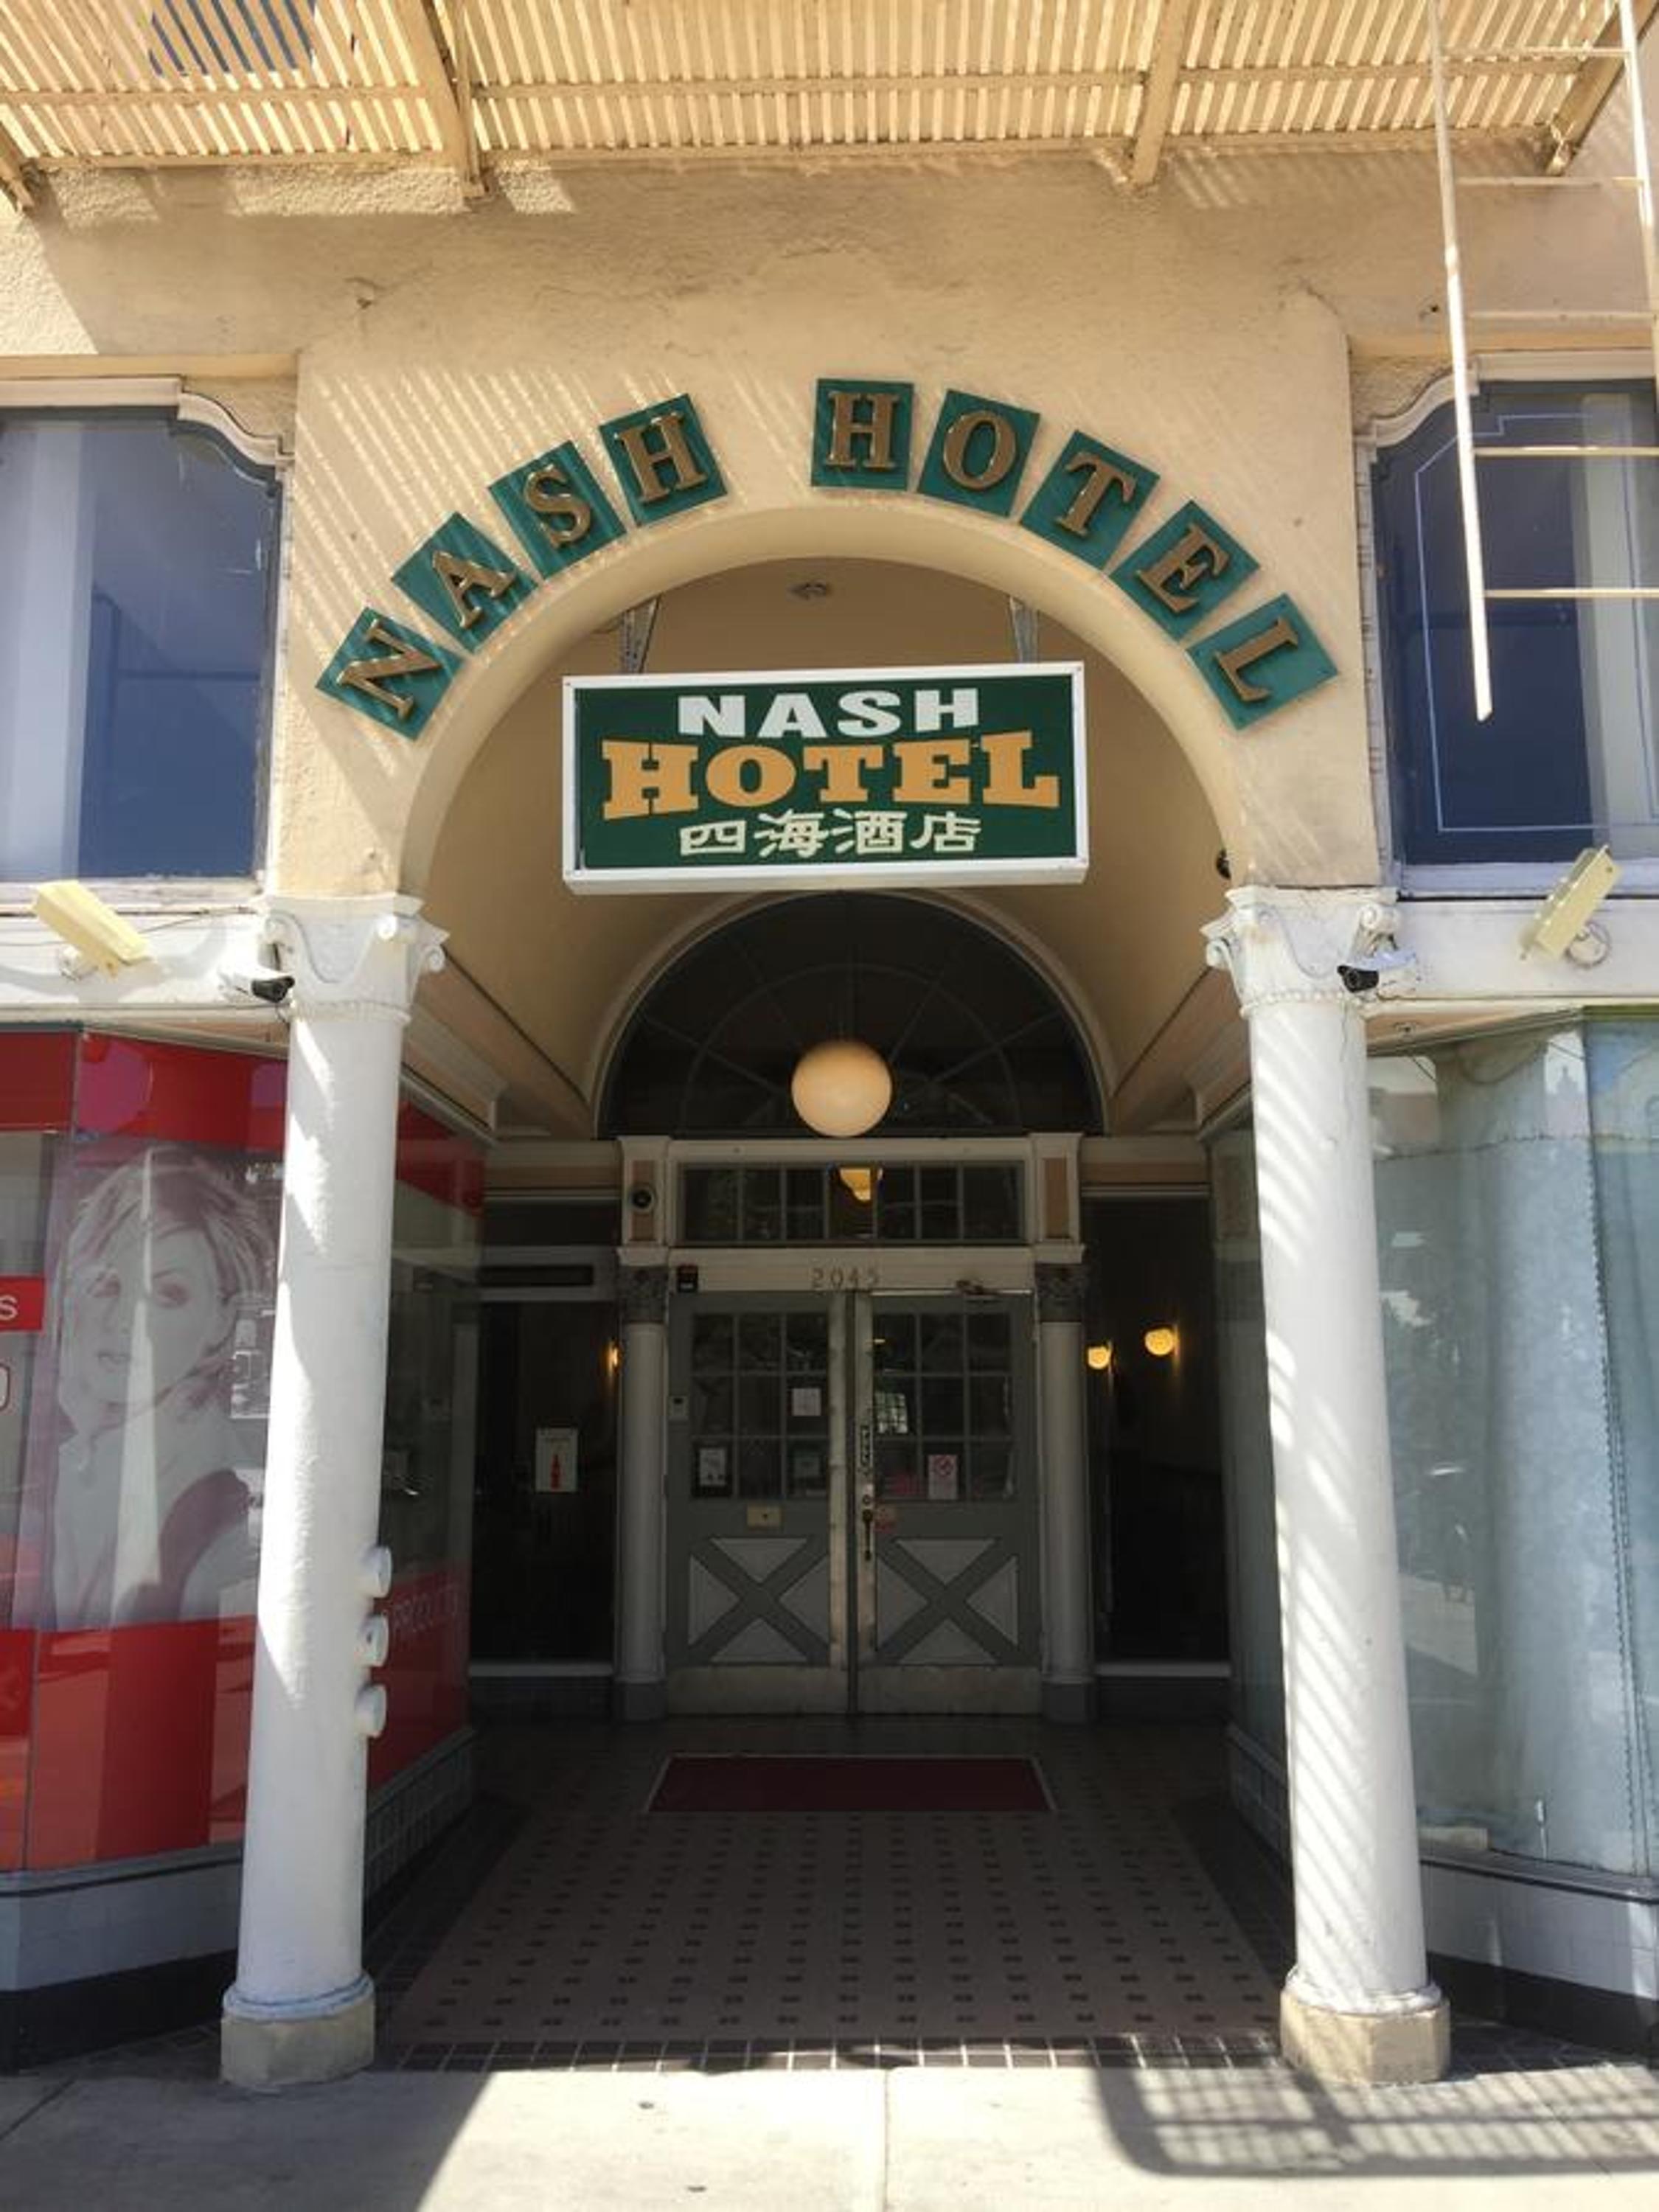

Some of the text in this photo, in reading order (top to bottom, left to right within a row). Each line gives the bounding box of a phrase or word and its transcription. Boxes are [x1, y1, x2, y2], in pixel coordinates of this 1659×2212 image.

[336, 391, 1299, 720] NASH HOTEL
[678, 687, 979, 738] NASH
[601, 729, 1060, 821] HOTEL
[678, 807, 982, 859] 四海酒店
